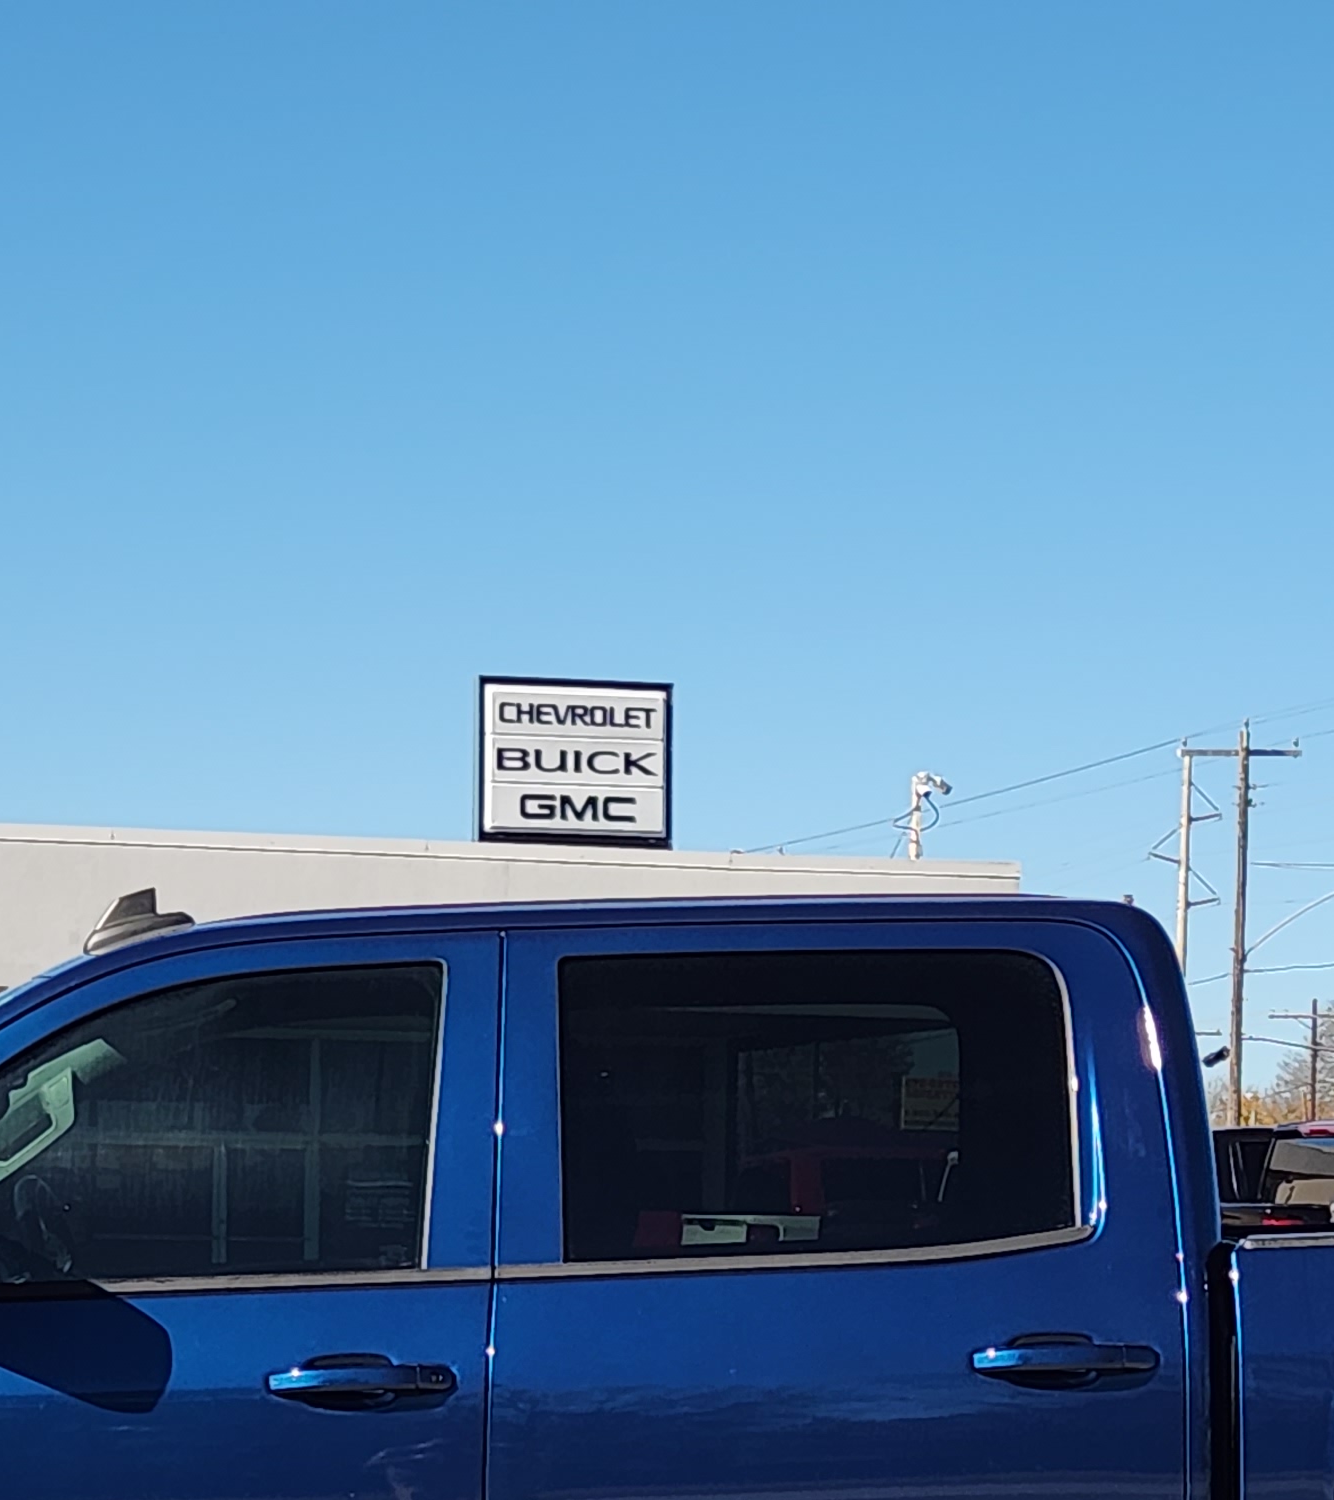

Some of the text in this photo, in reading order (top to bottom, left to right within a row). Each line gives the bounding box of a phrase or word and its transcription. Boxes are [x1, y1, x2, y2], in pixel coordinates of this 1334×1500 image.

[498, 701, 658, 730] CHEVROLET
[496, 747, 659, 777] BUICK
[519, 793, 637, 824] GMC
